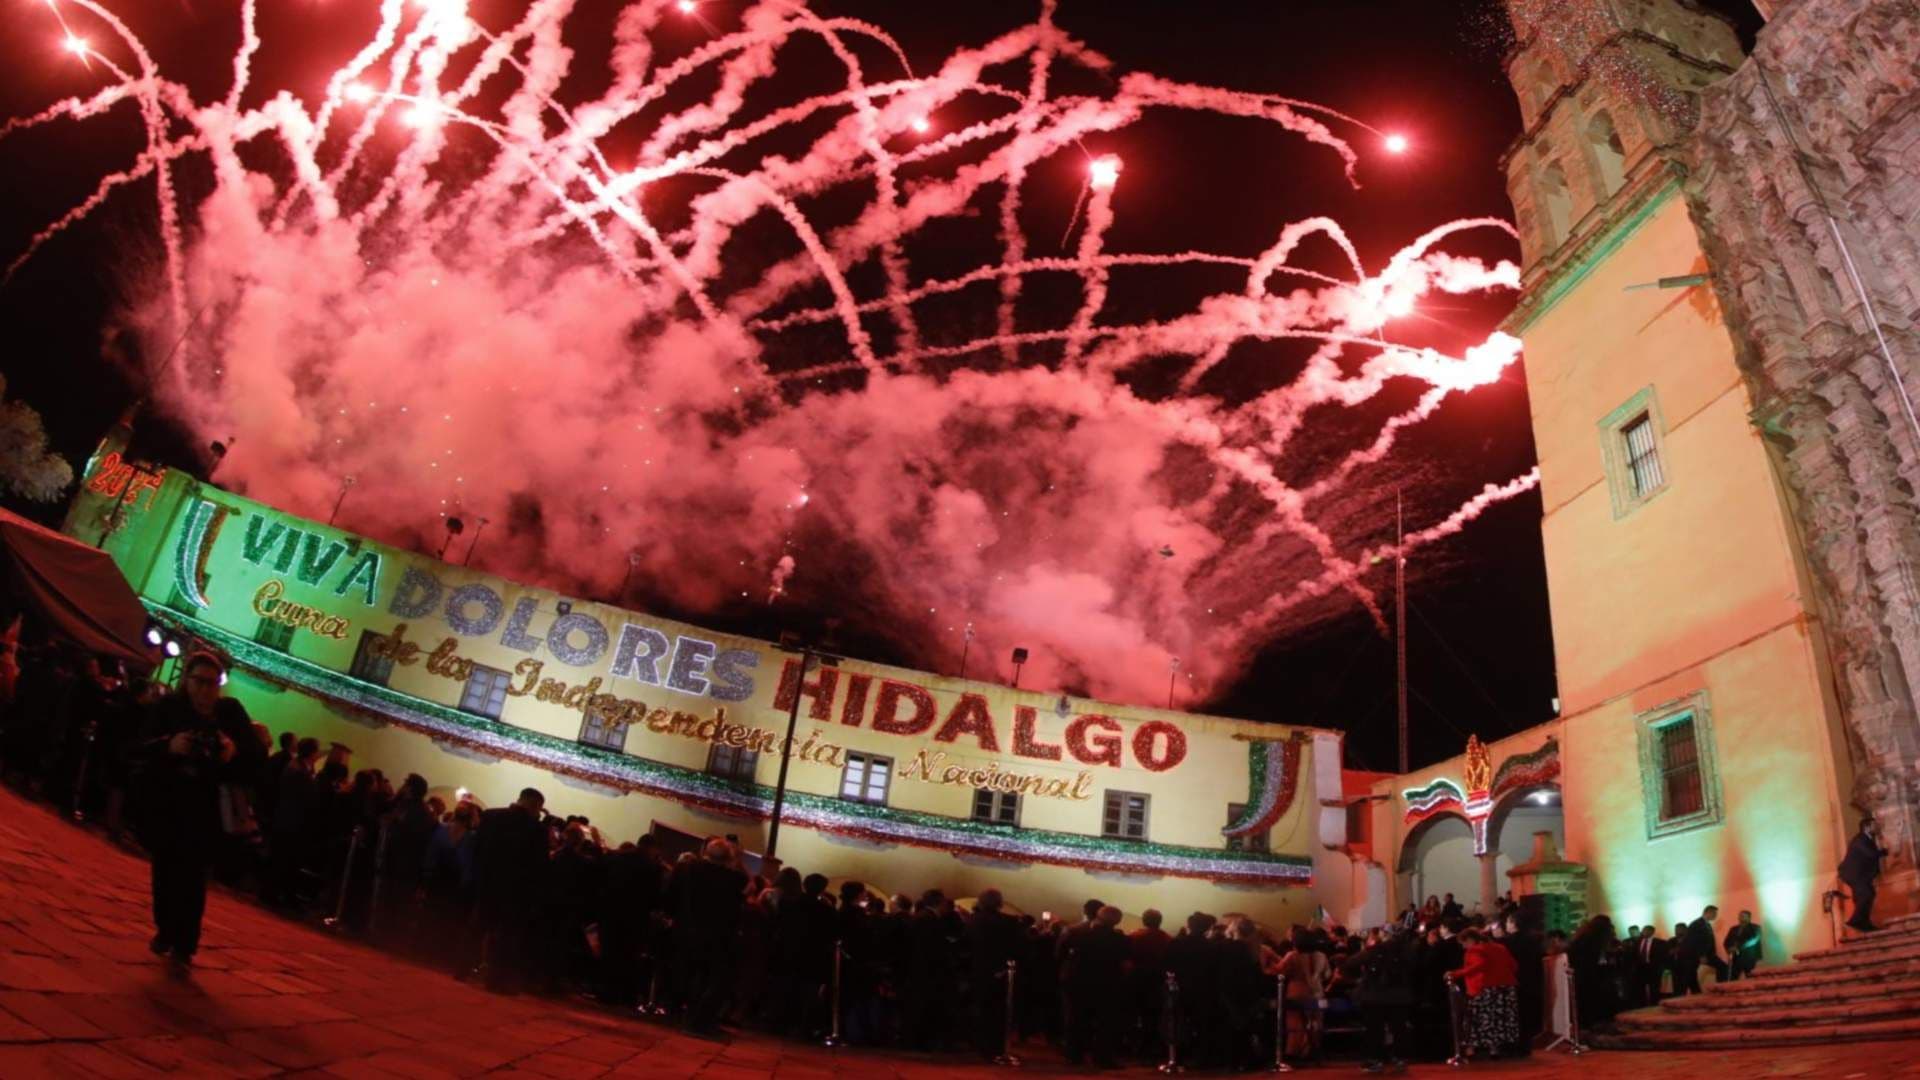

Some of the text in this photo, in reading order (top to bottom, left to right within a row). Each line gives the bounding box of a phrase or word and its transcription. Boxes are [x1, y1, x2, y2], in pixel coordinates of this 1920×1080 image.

[242, 513, 1188, 772] VIVA DOLORES HIDALGO
[253, 578, 351, 640] Cuna
[367, 623, 420, 666] de
[506, 657, 846, 768] Independencia
[899, 748, 1095, 801] Nacional
